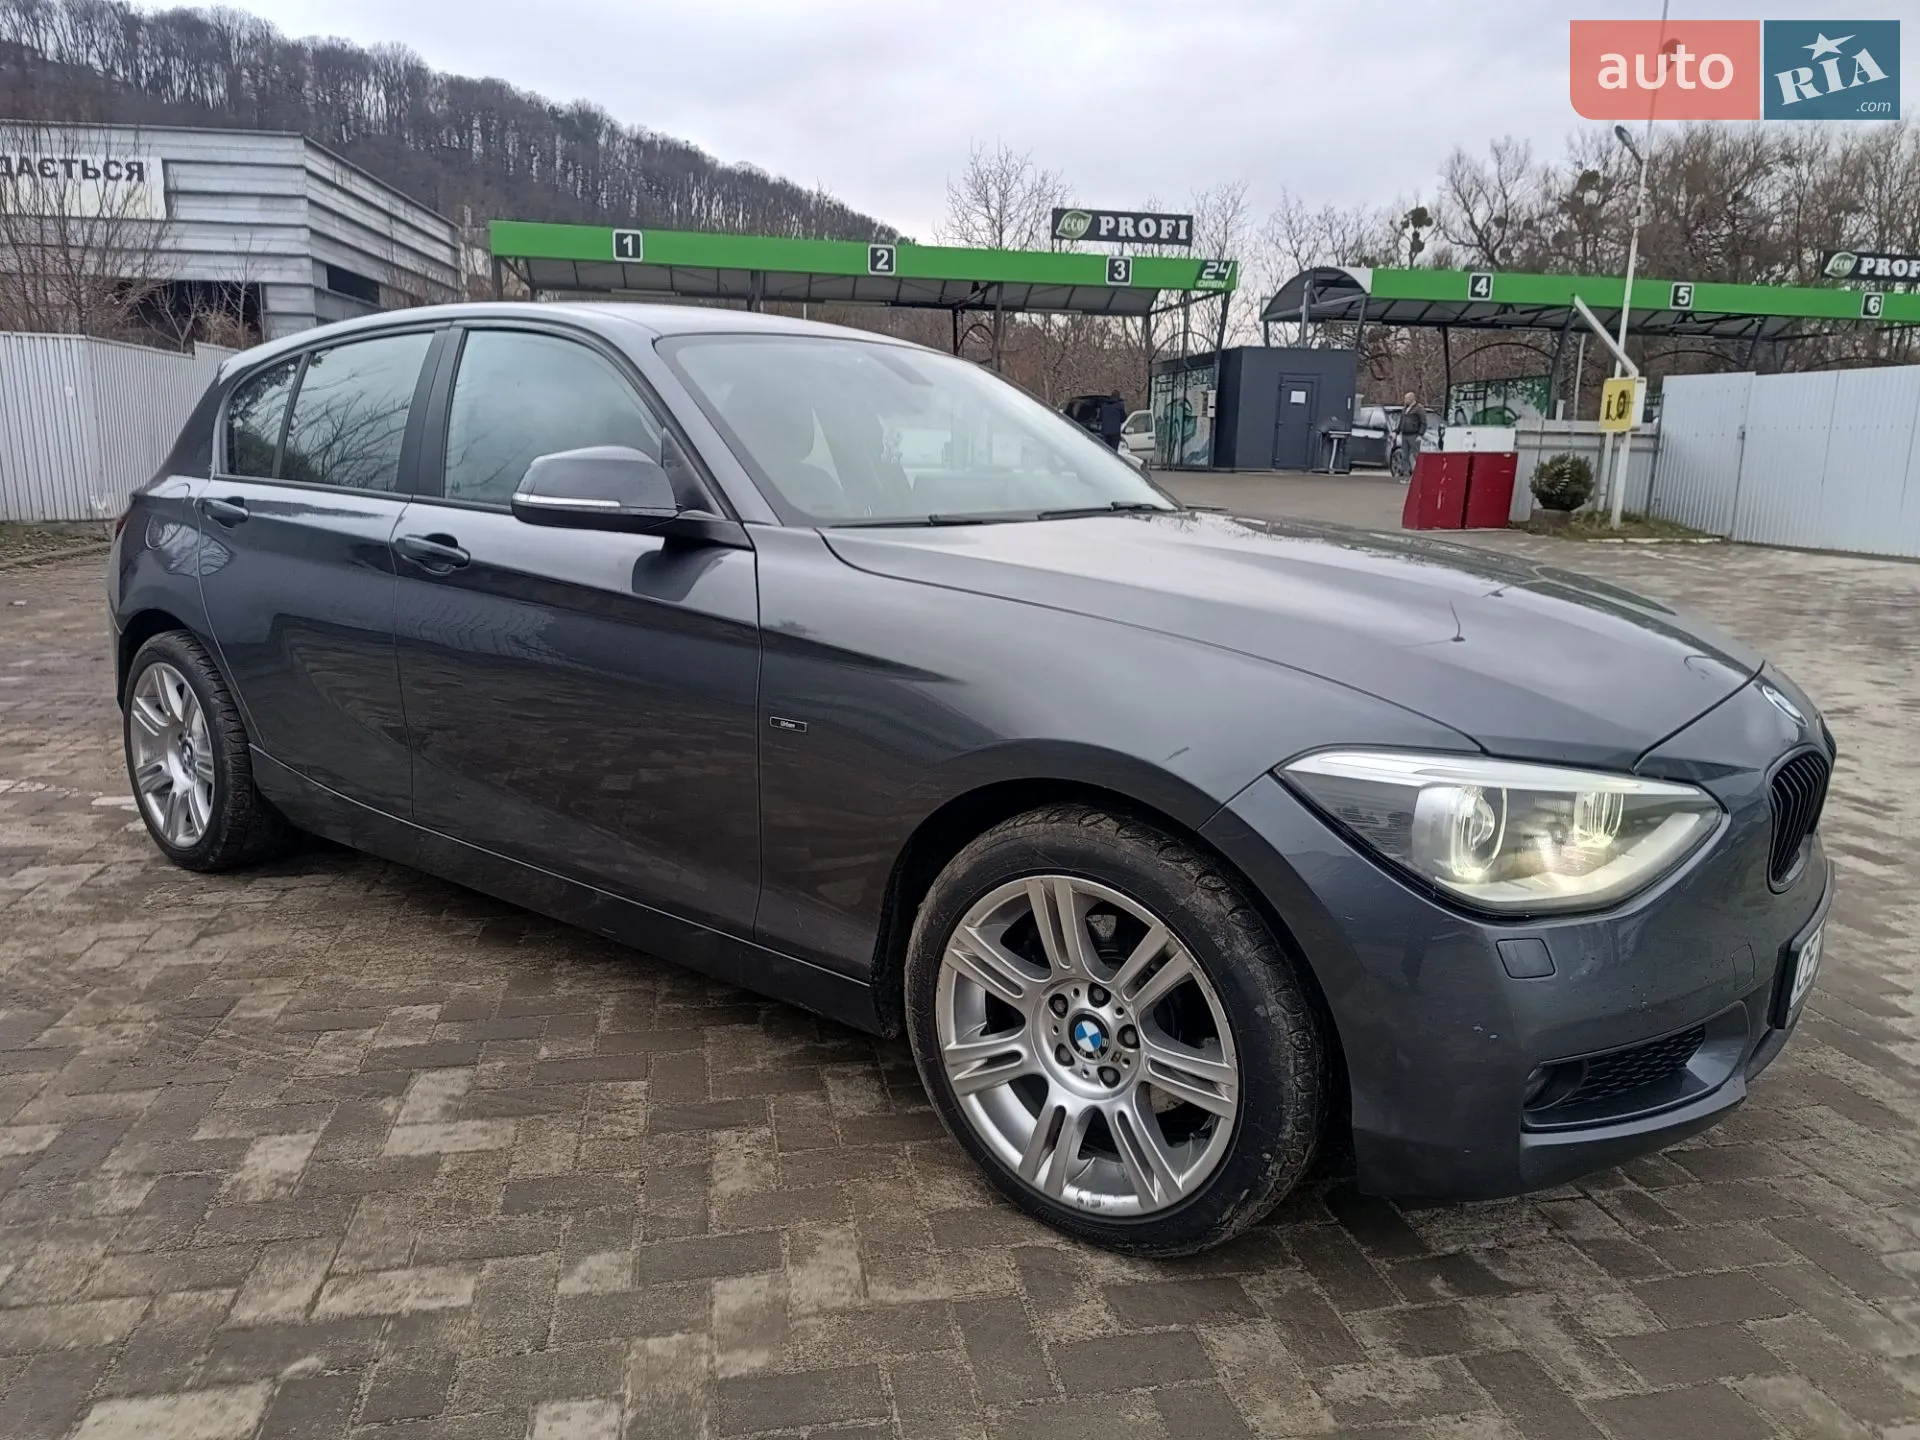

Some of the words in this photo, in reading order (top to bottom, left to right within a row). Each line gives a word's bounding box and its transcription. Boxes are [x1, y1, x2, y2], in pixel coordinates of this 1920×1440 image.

[1098, 216, 1189, 240] PROFI
[622, 234, 634, 256] 1
[876, 249, 889, 270] 2
[1113, 260, 1126, 280] 3
[1202, 261, 1233, 280] 24
[1474, 277, 1490, 296] 4
[1677, 286, 1690, 304] 5
[1867, 297, 1880, 314] 6
